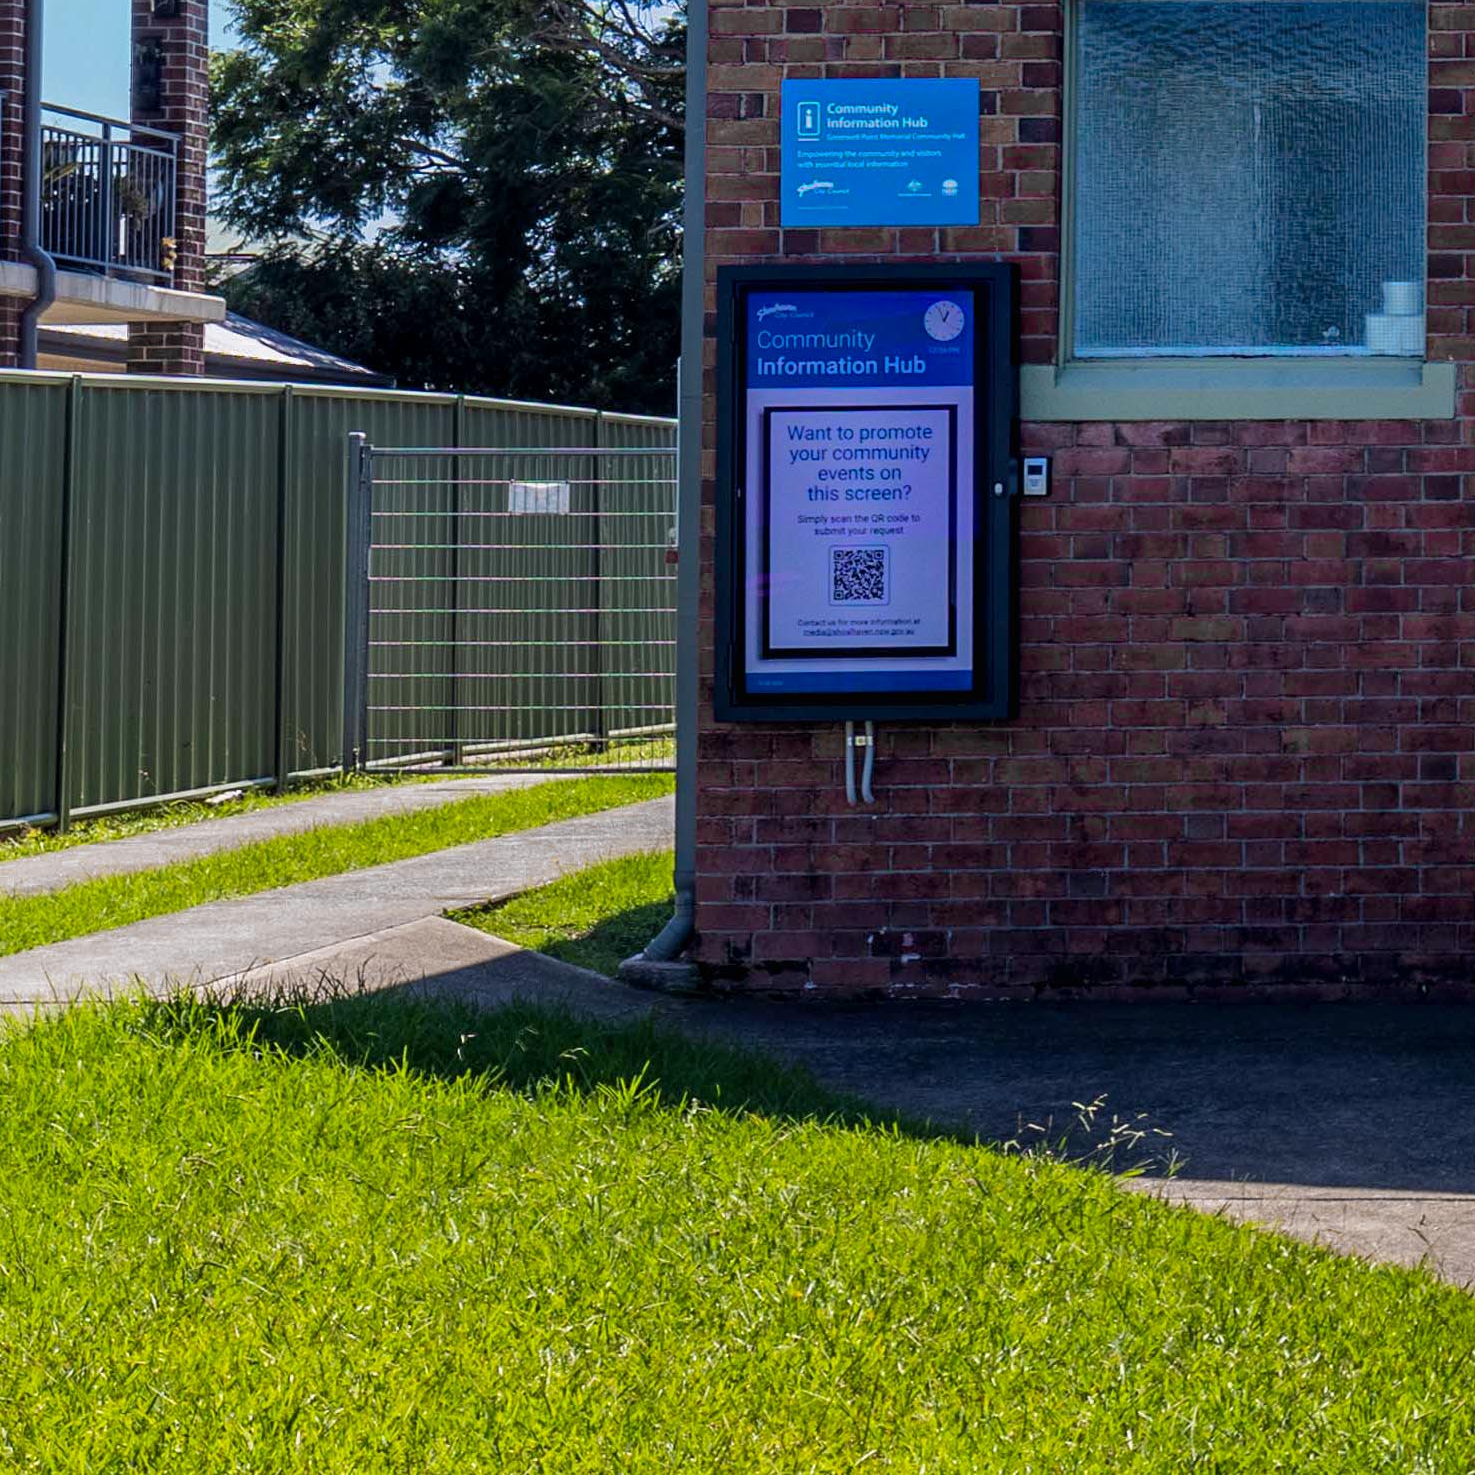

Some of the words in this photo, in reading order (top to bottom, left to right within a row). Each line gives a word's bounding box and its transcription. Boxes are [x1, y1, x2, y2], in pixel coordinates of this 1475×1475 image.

[826, 103, 898, 116] Community
[827, 118, 899, 128] Information
[903, 117, 928, 128] Hub
[757, 330, 876, 352] Community
[757, 357, 878, 375] Information
[884, 355, 926, 374] Hub
[787, 425, 832, 441] Want
[836, 426, 854, 440] to
[859, 424, 933, 444] promote
[789, 447, 829, 465] your
[832, 443, 930, 463] community
[818, 467, 875, 481] events
[880, 467, 902, 480] on
[807, 485, 839, 501] this
[845, 484, 912, 501] screen?
[854, 514, 870, 523] the
[887, 513, 909, 523] code
[911, 512, 921, 522] to
